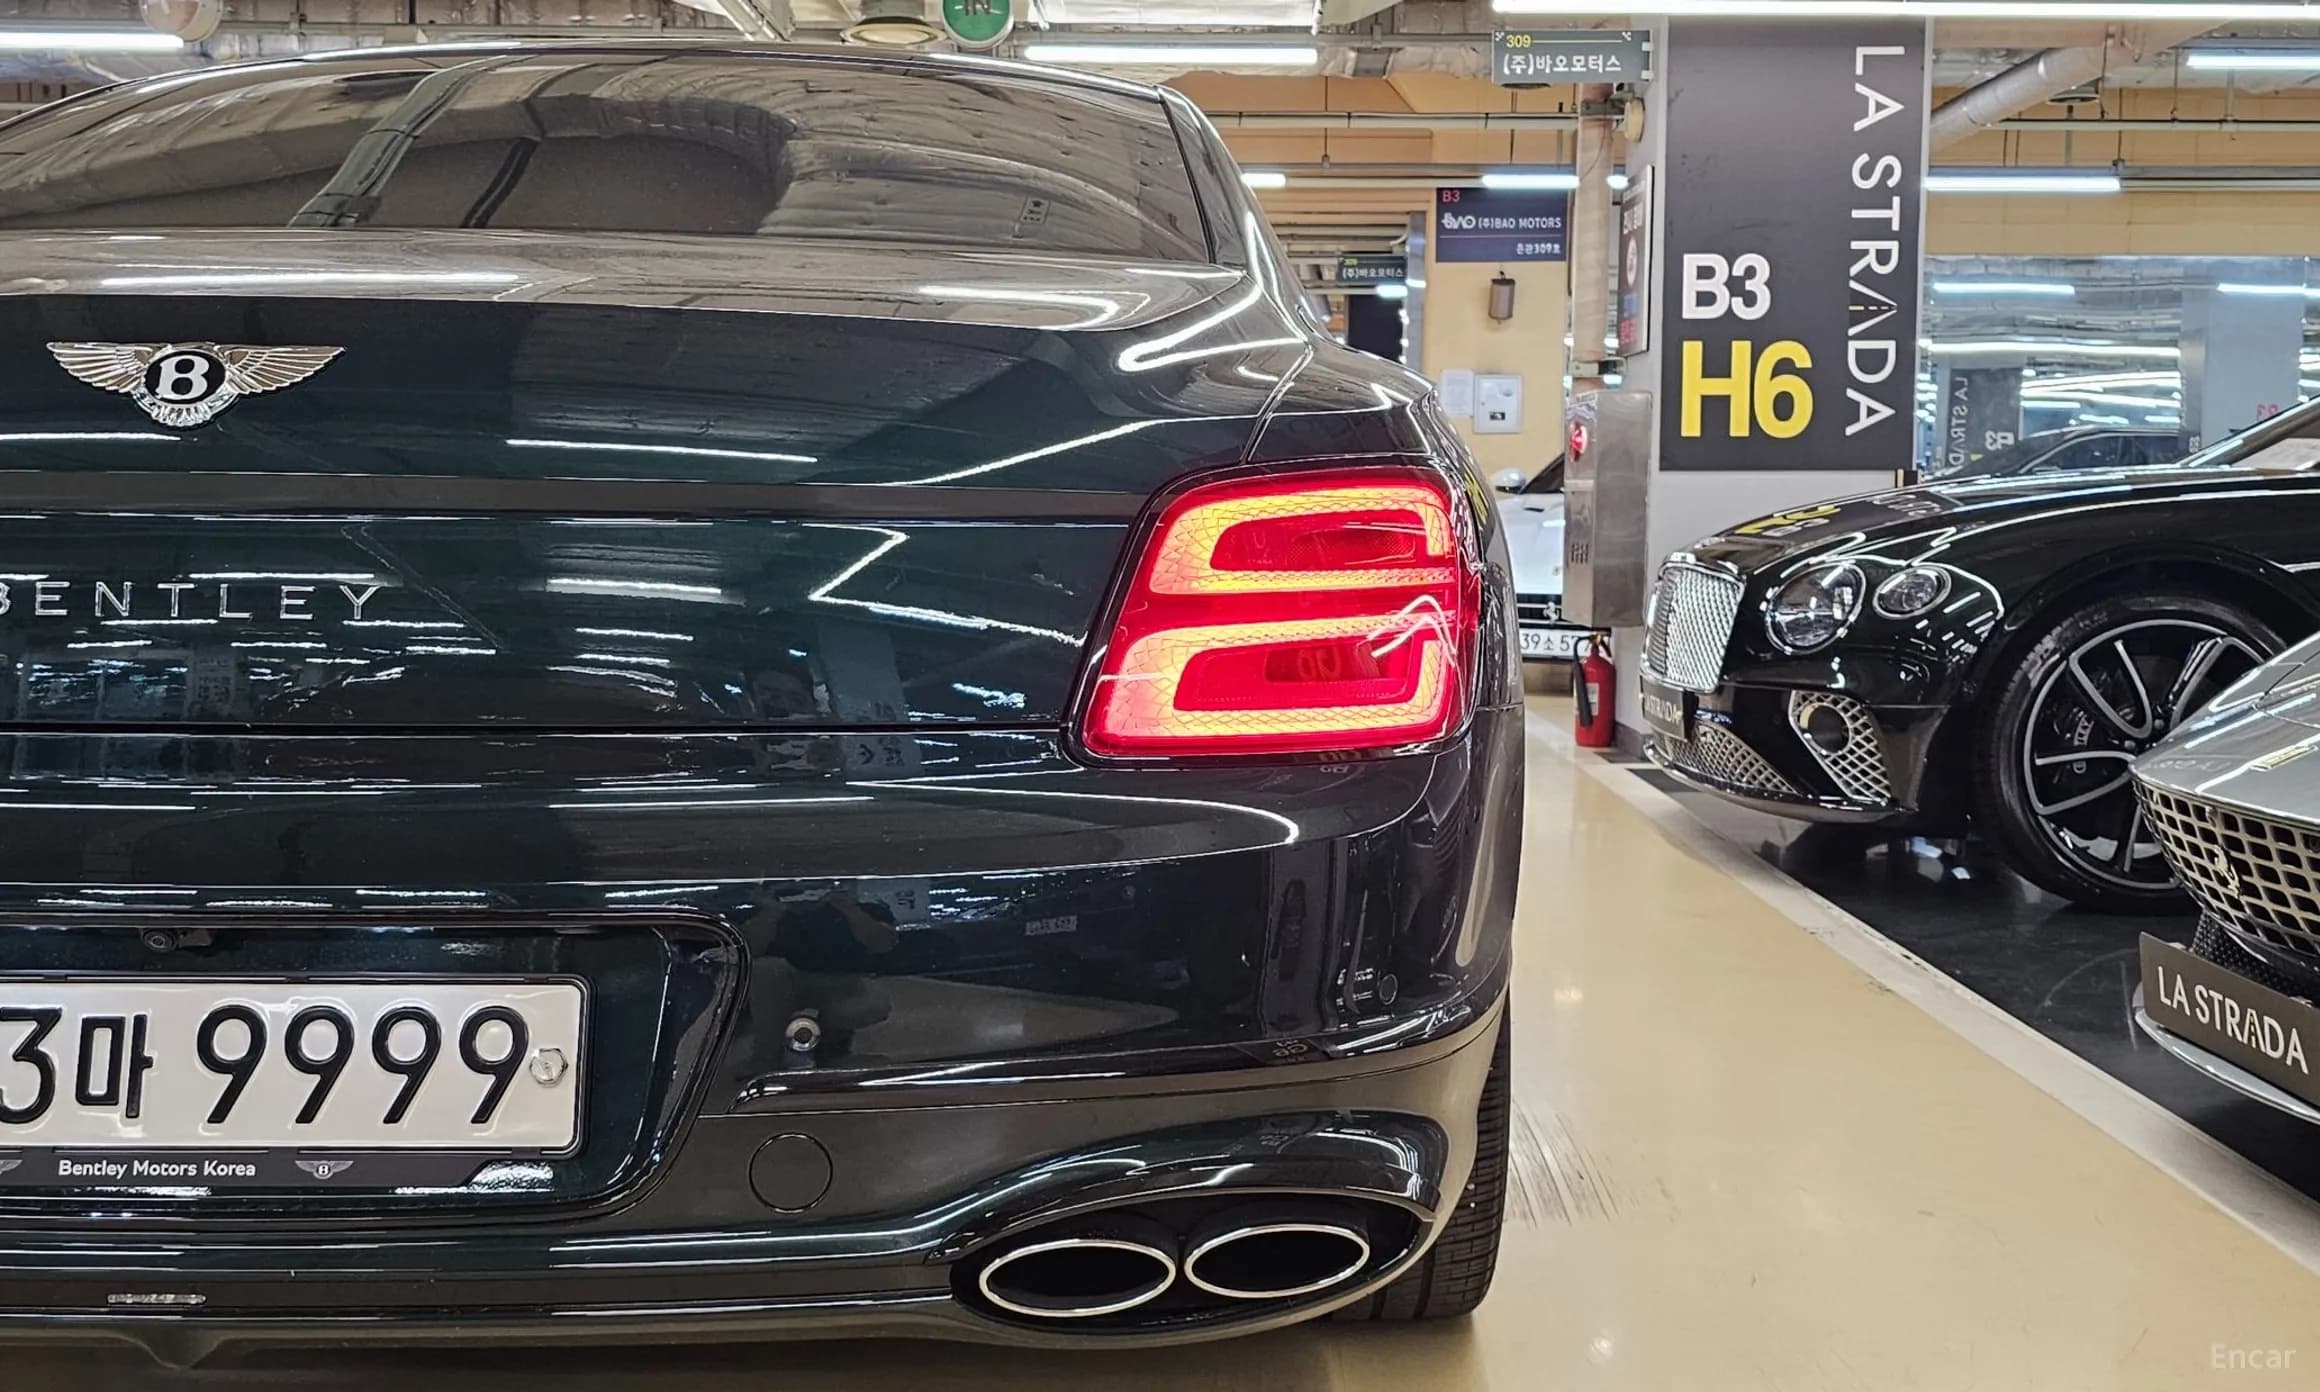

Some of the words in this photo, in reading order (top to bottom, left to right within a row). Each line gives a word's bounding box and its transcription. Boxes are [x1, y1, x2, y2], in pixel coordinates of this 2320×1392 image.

[1503, 53, 1622, 75] (주)바오모터스
[1506, 35, 1531, 48] 309
[1854, 46, 1905, 131] LA
[1442, 190, 1461, 202] B3
[1519, 216, 1562, 229] MOTORS
[1681, 253, 1771, 321] B3
[1844, 153, 1902, 437] STRADA
[155, 355, 210, 400] B
[1680, 341, 1814, 438] H6
[2157, 966, 2191, 1016] LA
[2194, 984, 2309, 1075] STRADA
[0, 1006, 154, 1125] 3마
[196, 1004, 530, 1125] 9999
[58, 1159, 128, 1179] Bentley
[132, 1159, 198, 1177] Motors
[203, 1159, 256, 1177] Korea
